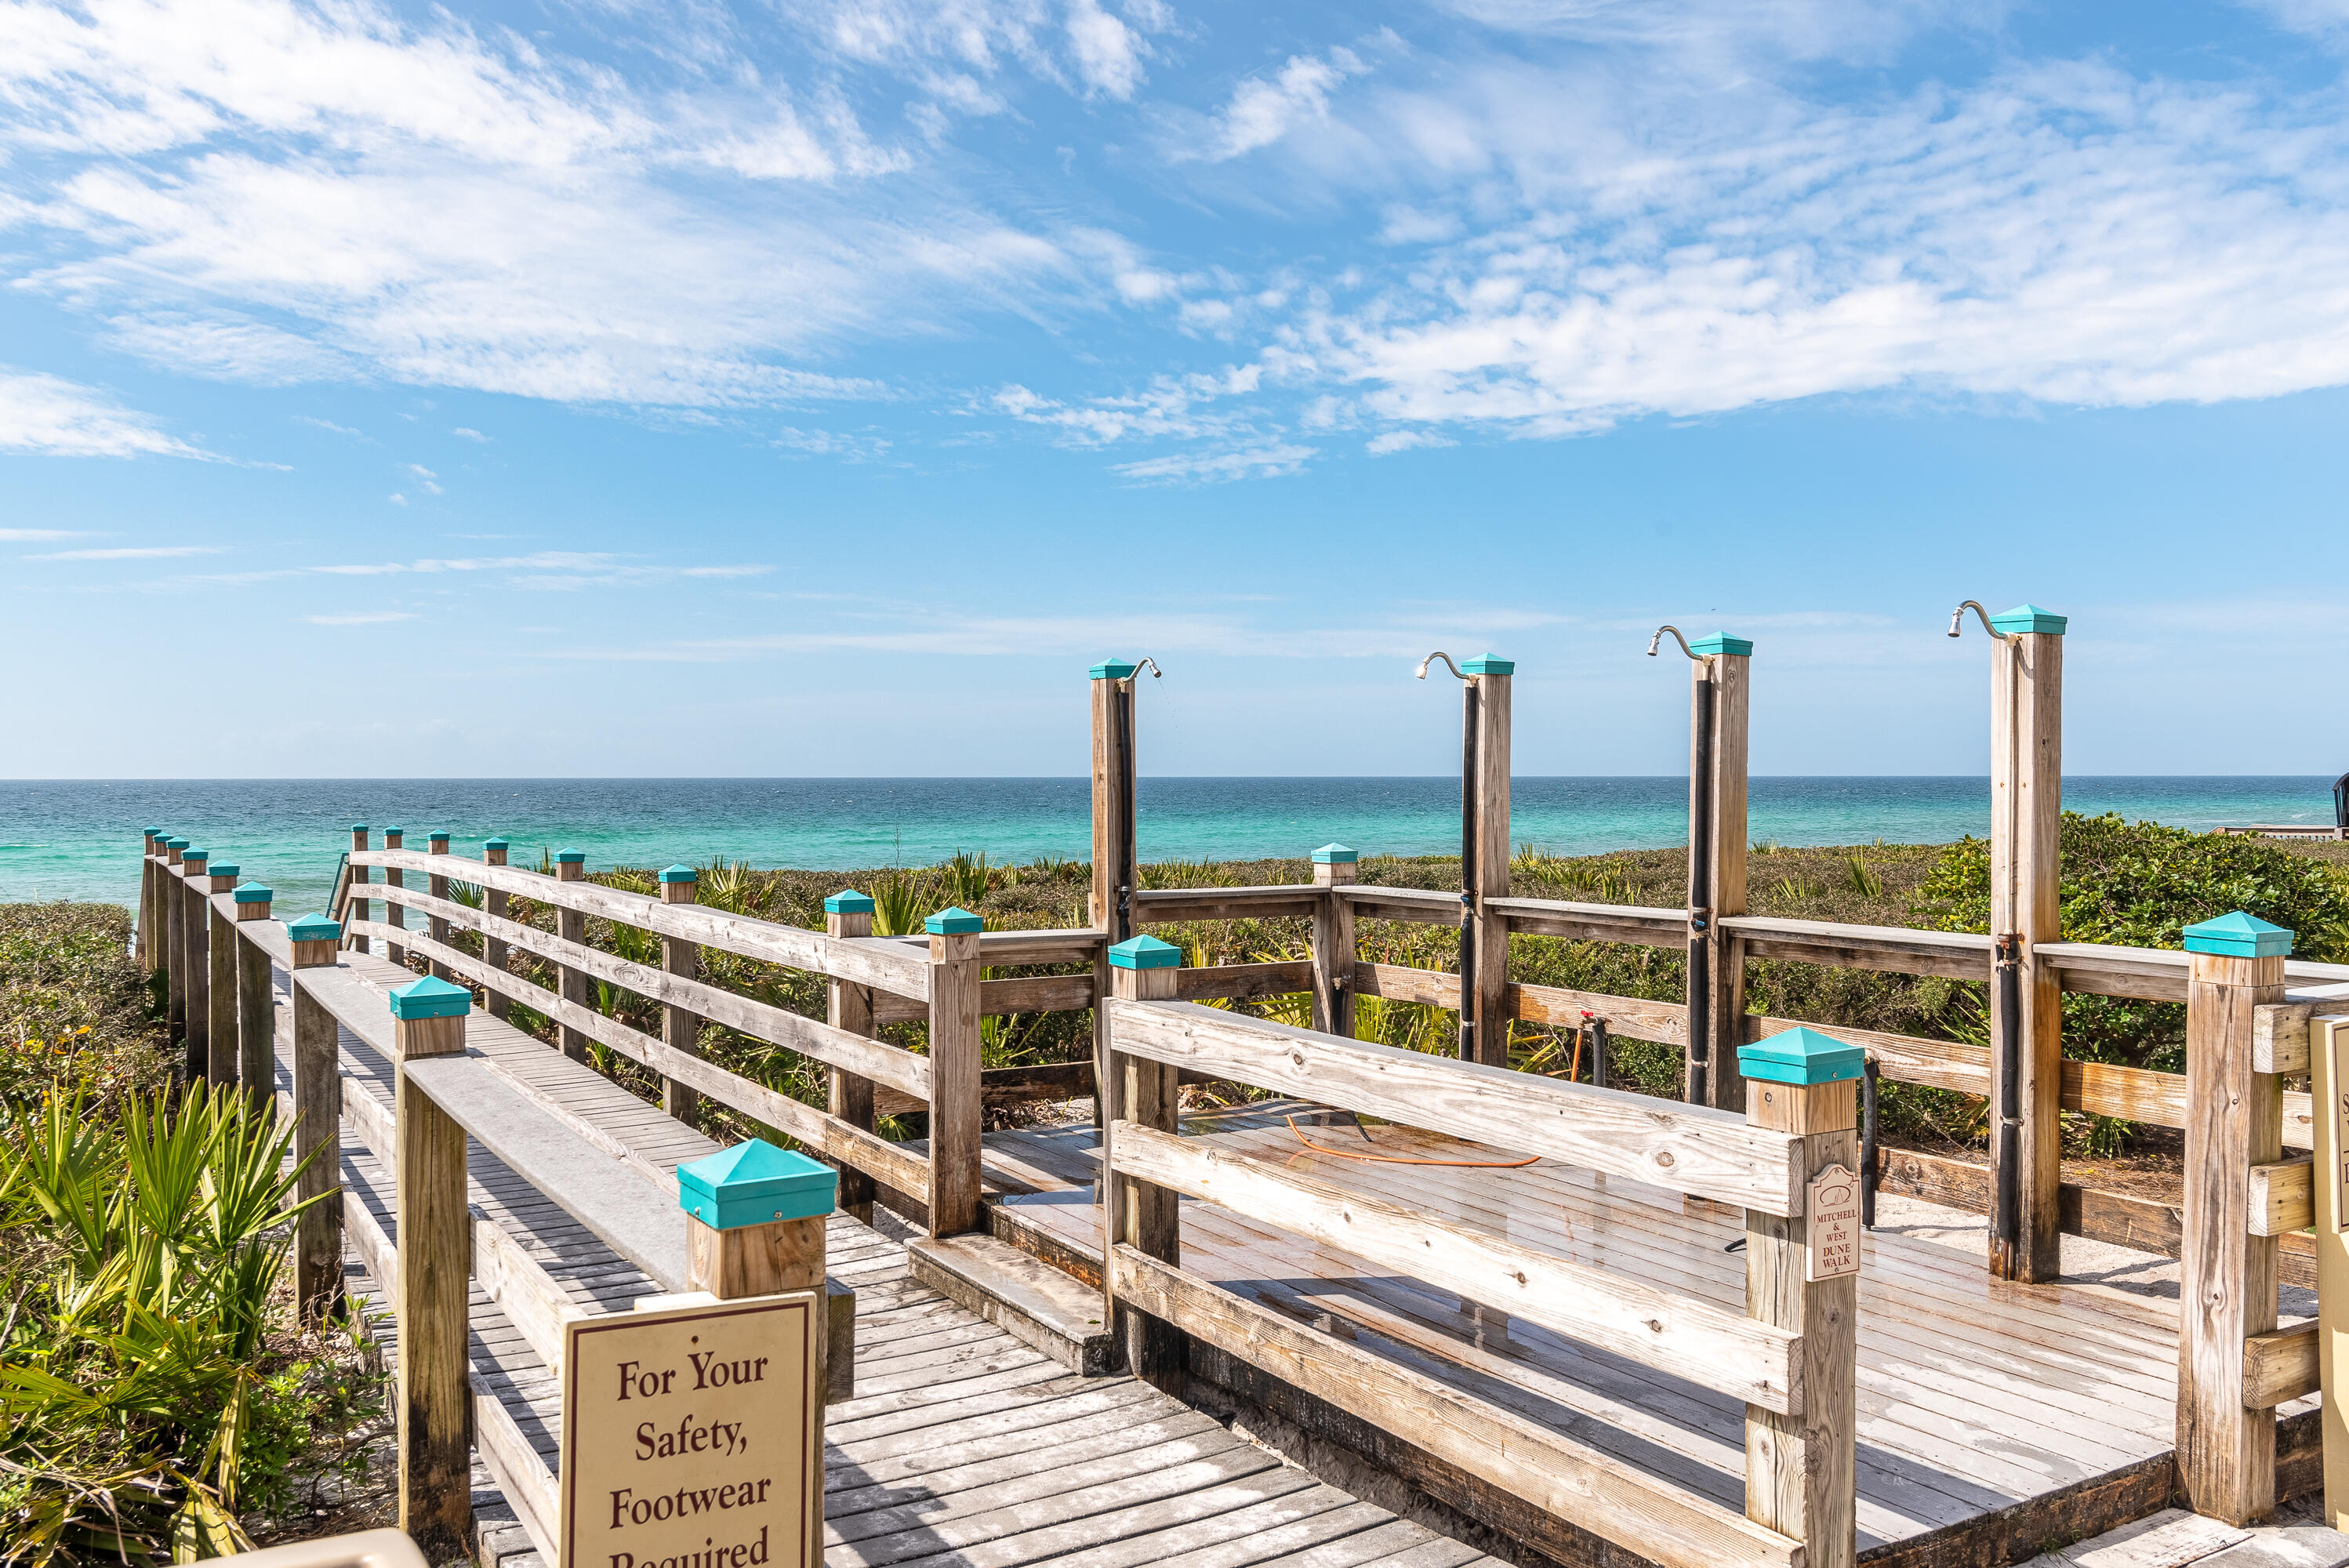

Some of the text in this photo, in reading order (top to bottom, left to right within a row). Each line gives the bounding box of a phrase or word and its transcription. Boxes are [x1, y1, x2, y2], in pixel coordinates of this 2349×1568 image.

[1817, 1209, 1857, 1223] MITCHELL
[1833, 1222, 1840, 1231] &
[1826, 1231, 1847, 1242] WEST
[1823, 1243, 1850, 1257] DUNE
[1822, 1254, 1850, 1269] WALK
[616, 1351, 769, 1402] For Your
[635, 1414, 748, 1461] Safety,
[608, 1478, 772, 1530] Footwear
[608, 1524, 770, 1568] uired
